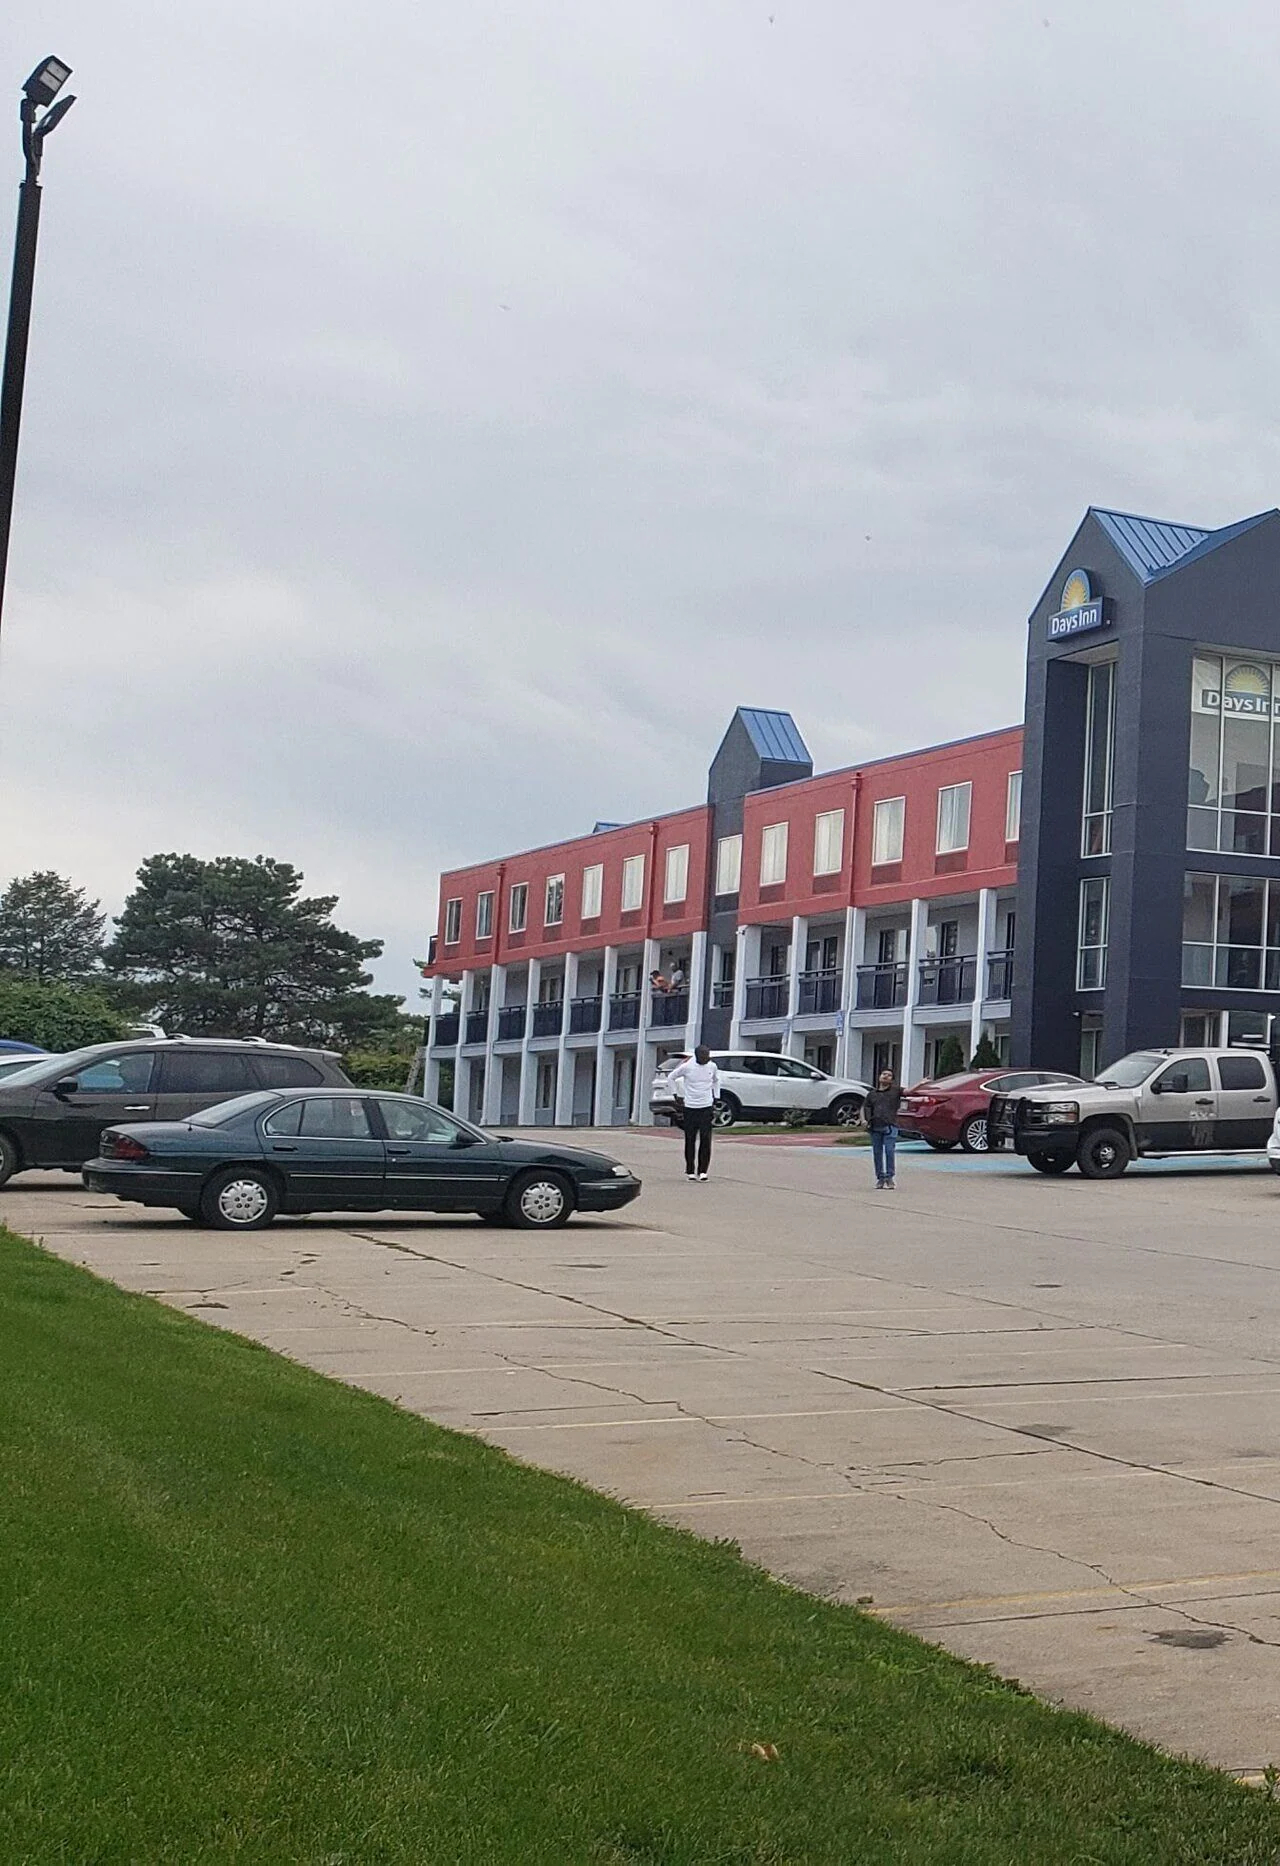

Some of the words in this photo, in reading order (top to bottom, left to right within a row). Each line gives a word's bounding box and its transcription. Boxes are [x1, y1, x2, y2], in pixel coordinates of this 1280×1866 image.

[1051, 614, 1078, 635] Days
[1079, 609, 1097, 627] Inn
[1207, 691, 1254, 711] Days
